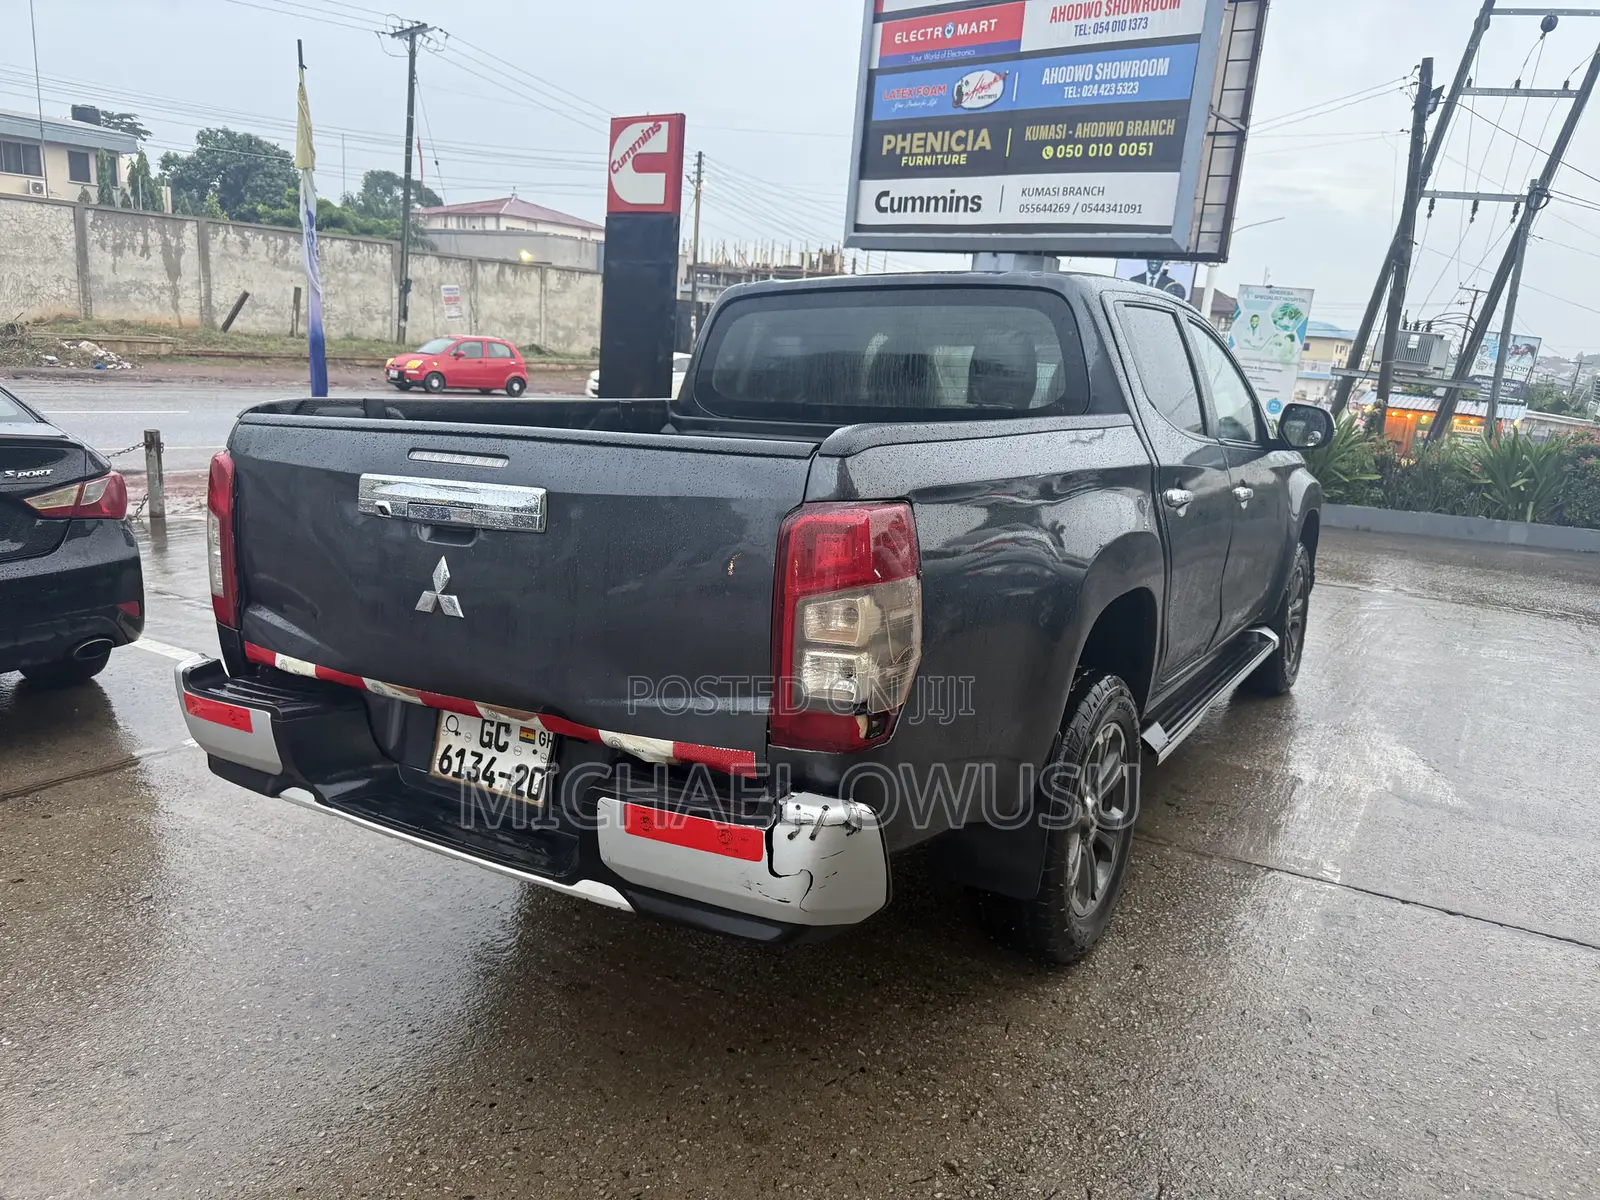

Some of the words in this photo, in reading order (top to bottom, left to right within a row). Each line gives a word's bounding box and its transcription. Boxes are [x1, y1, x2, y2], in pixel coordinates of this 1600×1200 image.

[1050, 2, 1102, 23] AHODWO
[1074, 25, 1092, 37] TEL:
[1093, 21, 1110, 35] 054
[1111, 19, 1126, 32] 010
[1128, 17, 1149, 31] 1373
[923, 51, 940, 61] World
[947, 48, 976, 59] Electronics
[1042, 63, 1093, 85] AHODWO
[1095, 57, 1170, 80] SHOWROOM
[883, 87, 913, 101] LATEX
[915, 84, 947, 98] FOAM
[1064, 86, 1080, 99] TEL:
[1082, 84, 1097, 97] 024
[1099, 83, 1115, 96] 423
[1116, 81, 1139, 95] 5323
[1025, 123, 1067, 141] KUMASI
[1074, 120, 1124, 139] AHODWO
[1126, 118, 1176, 137] BRANCH
[610, 121, 662, 175] Cummins
[881, 127, 992, 156] PHENICIA
[1056, 144, 1083, 159] 050
[1088, 142, 1113, 158] 010
[1118, 141, 1154, 157] 0051
[901, 153, 968, 167] FURNITURE
[1021, 186, 1060, 197] KUMASI
[1062, 185, 1105, 197] BRANCH
[874, 188, 982, 214] Cummins
[1018, 203, 1071, 214] 055644269
[1081, 203, 1143, 215] 0544341091
[4, 468, 54, 479] SPORT
[479, 718, 511, 753] GC
